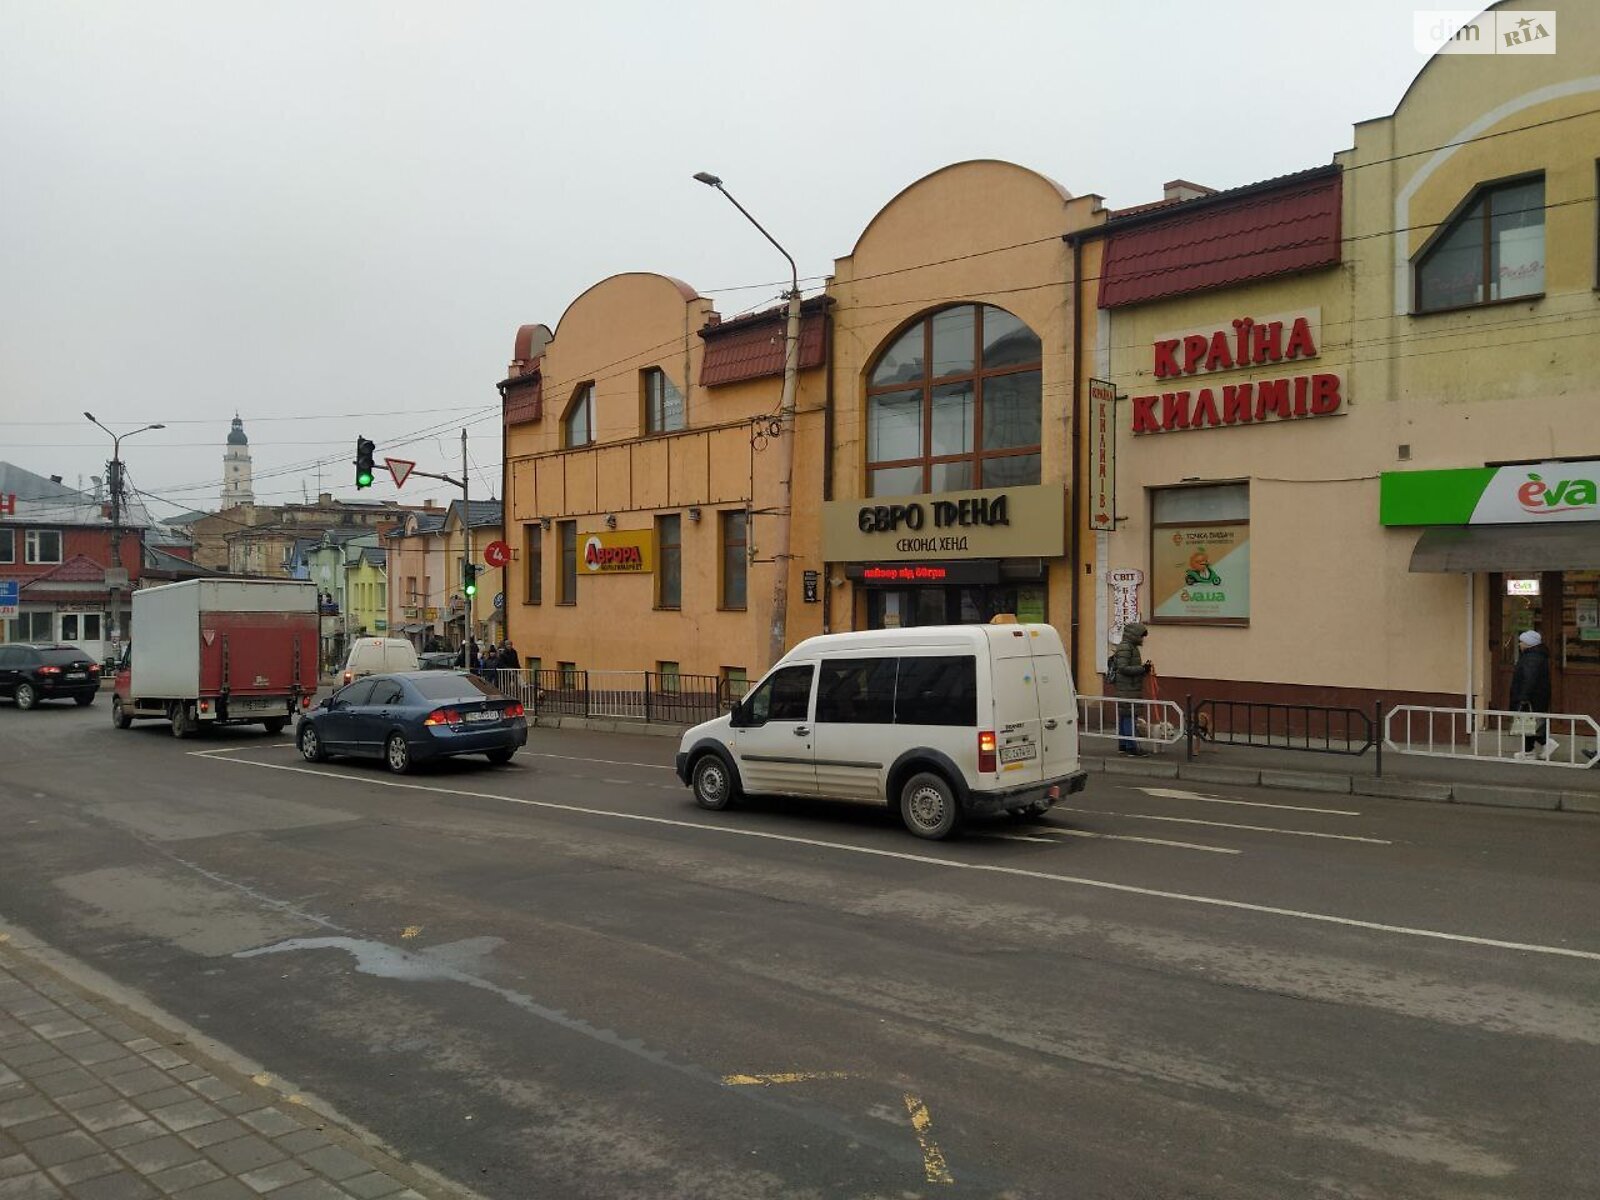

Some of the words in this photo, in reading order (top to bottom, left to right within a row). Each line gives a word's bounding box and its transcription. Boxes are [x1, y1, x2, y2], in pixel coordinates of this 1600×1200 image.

[1153, 317, 1317, 377] КРАЇНА
[1131, 373, 1342, 433] КИЛИМІВ
[858, 503, 925, 533] ЄВРО
[930, 494, 1010, 528] ТРЕНД
[586, 543, 641, 565] АВРОРА
[897, 538, 937, 552] СЕКОНД
[940, 536, 968, 551] ХЕНД
